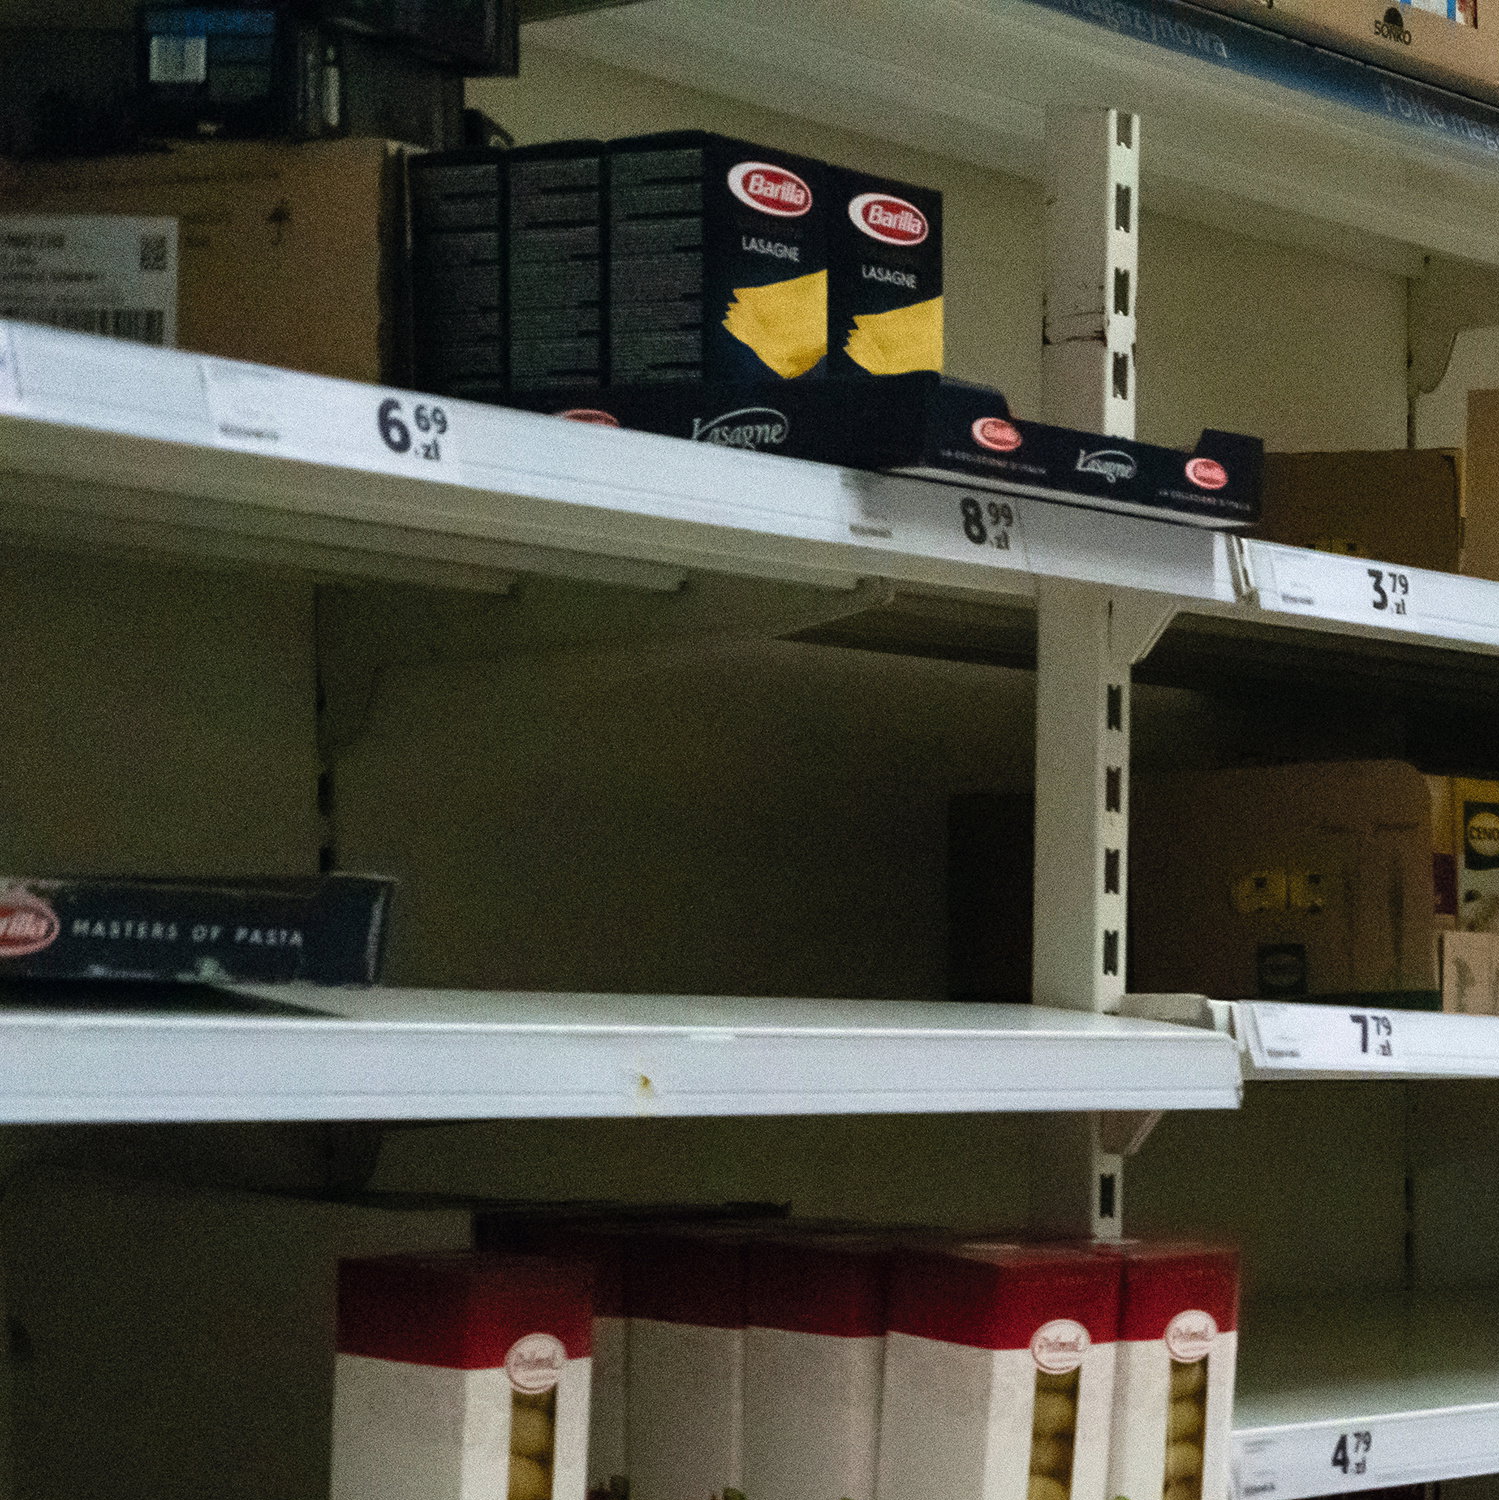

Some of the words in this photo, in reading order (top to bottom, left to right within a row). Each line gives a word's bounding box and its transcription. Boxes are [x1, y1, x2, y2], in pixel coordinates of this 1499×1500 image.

[748, 173, 808, 208] Barilla
[867, 204, 923, 236] Barilla
[742, 235, 800, 263] LASAGNE
[861, 264, 918, 290] LASAGNE
[72, 918, 179, 941] MASTERS
[192, 922, 223, 943] OF
[235, 928, 304, 949] PASTA
